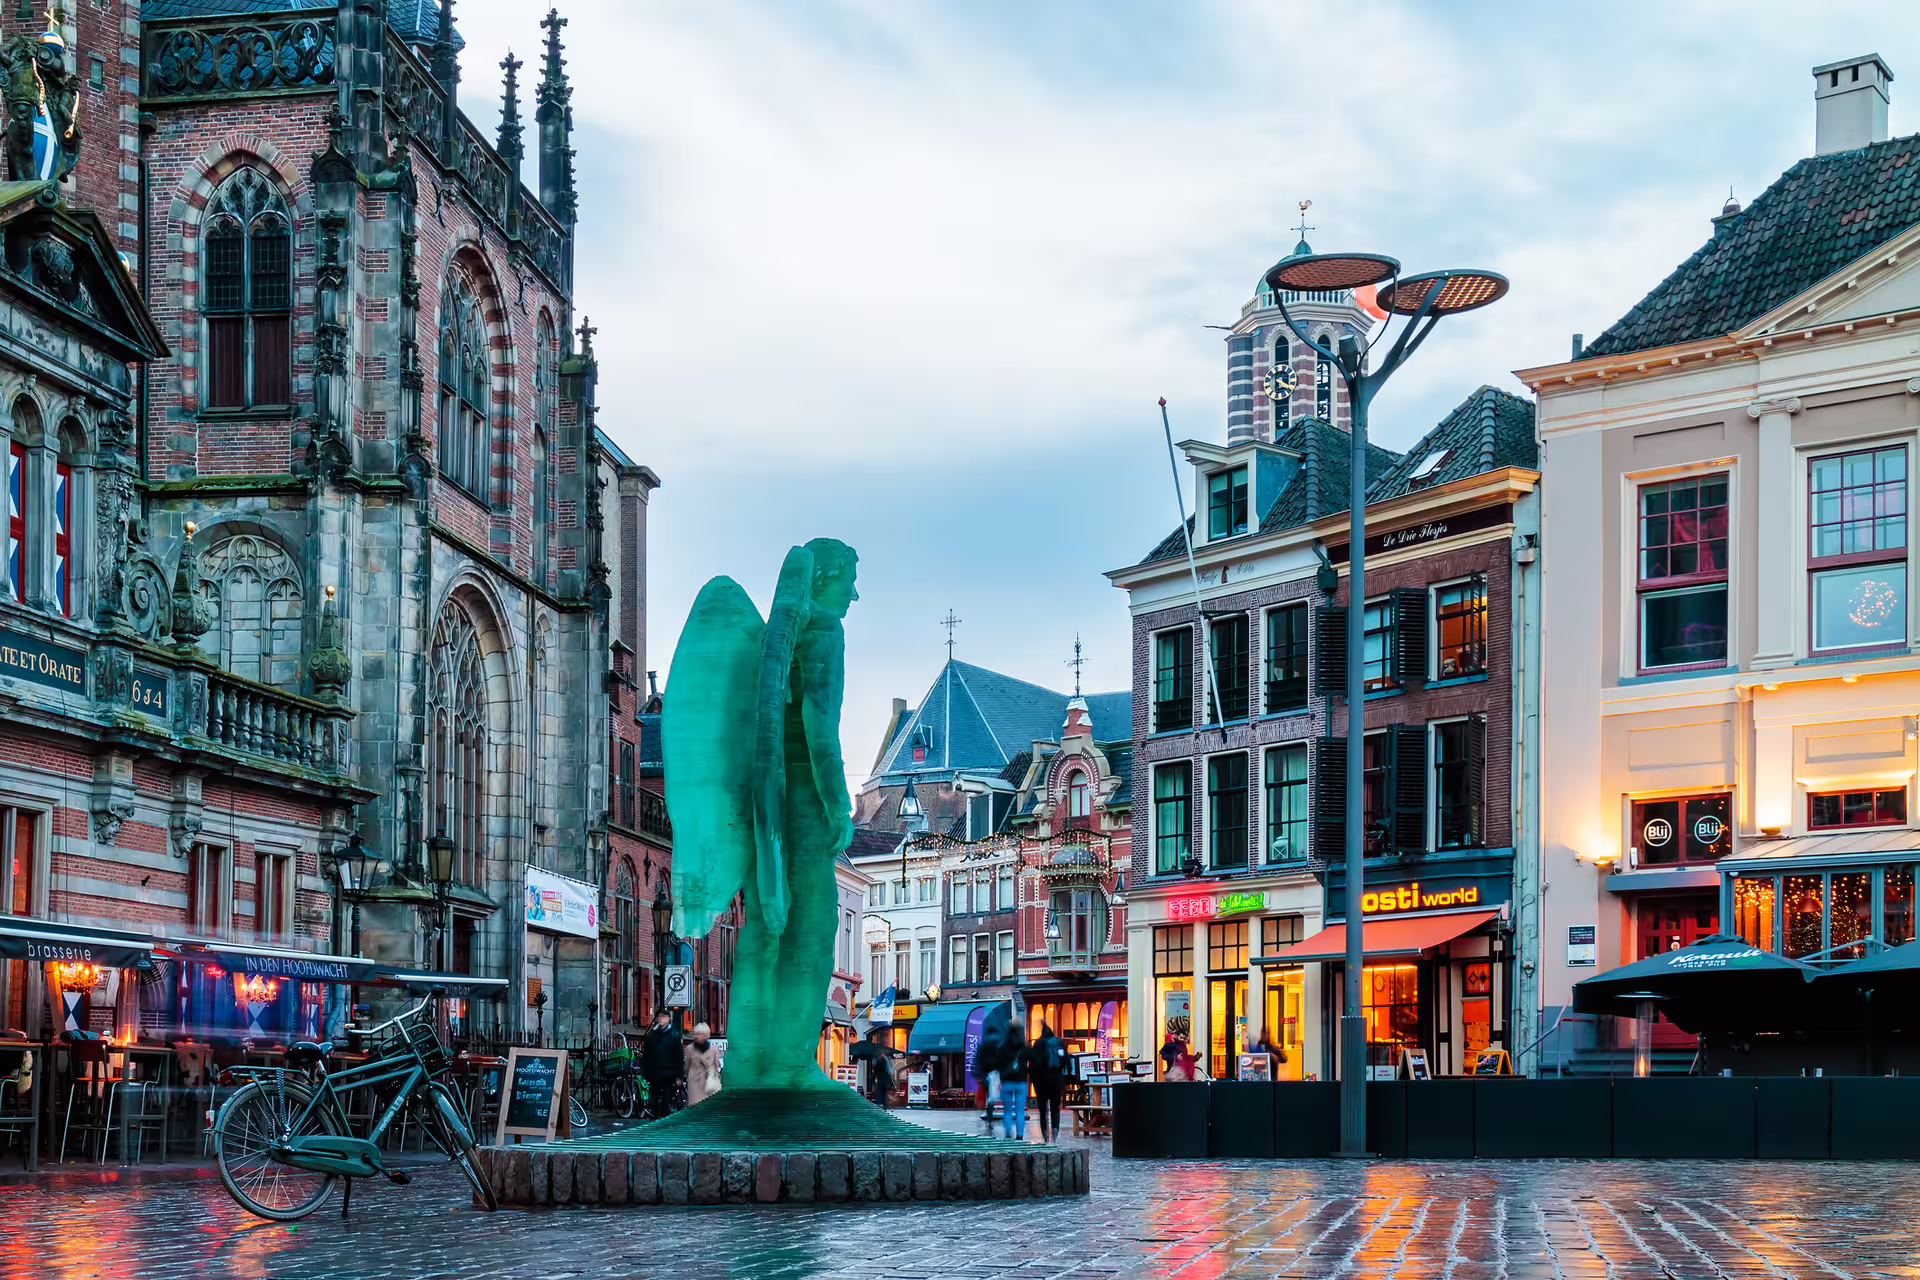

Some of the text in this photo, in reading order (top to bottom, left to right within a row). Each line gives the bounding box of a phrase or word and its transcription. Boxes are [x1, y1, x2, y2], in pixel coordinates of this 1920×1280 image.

[1383, 523, 1448, 547] De Drie Flesjes
[20, 651, 36, 671] ET
[39, 653, 82, 684] ORATE
[1648, 825, 1668, 839] Blij
[1698, 822, 1719, 836] Blij
[1362, 882, 1478, 912] osti world
[1169, 898, 1210, 918] FEBO
[27, 941, 92, 962] brasserie
[245, 956, 349, 978] IN DEN HOOFDWACHT
[518, 1077, 547, 1086] Lunch
